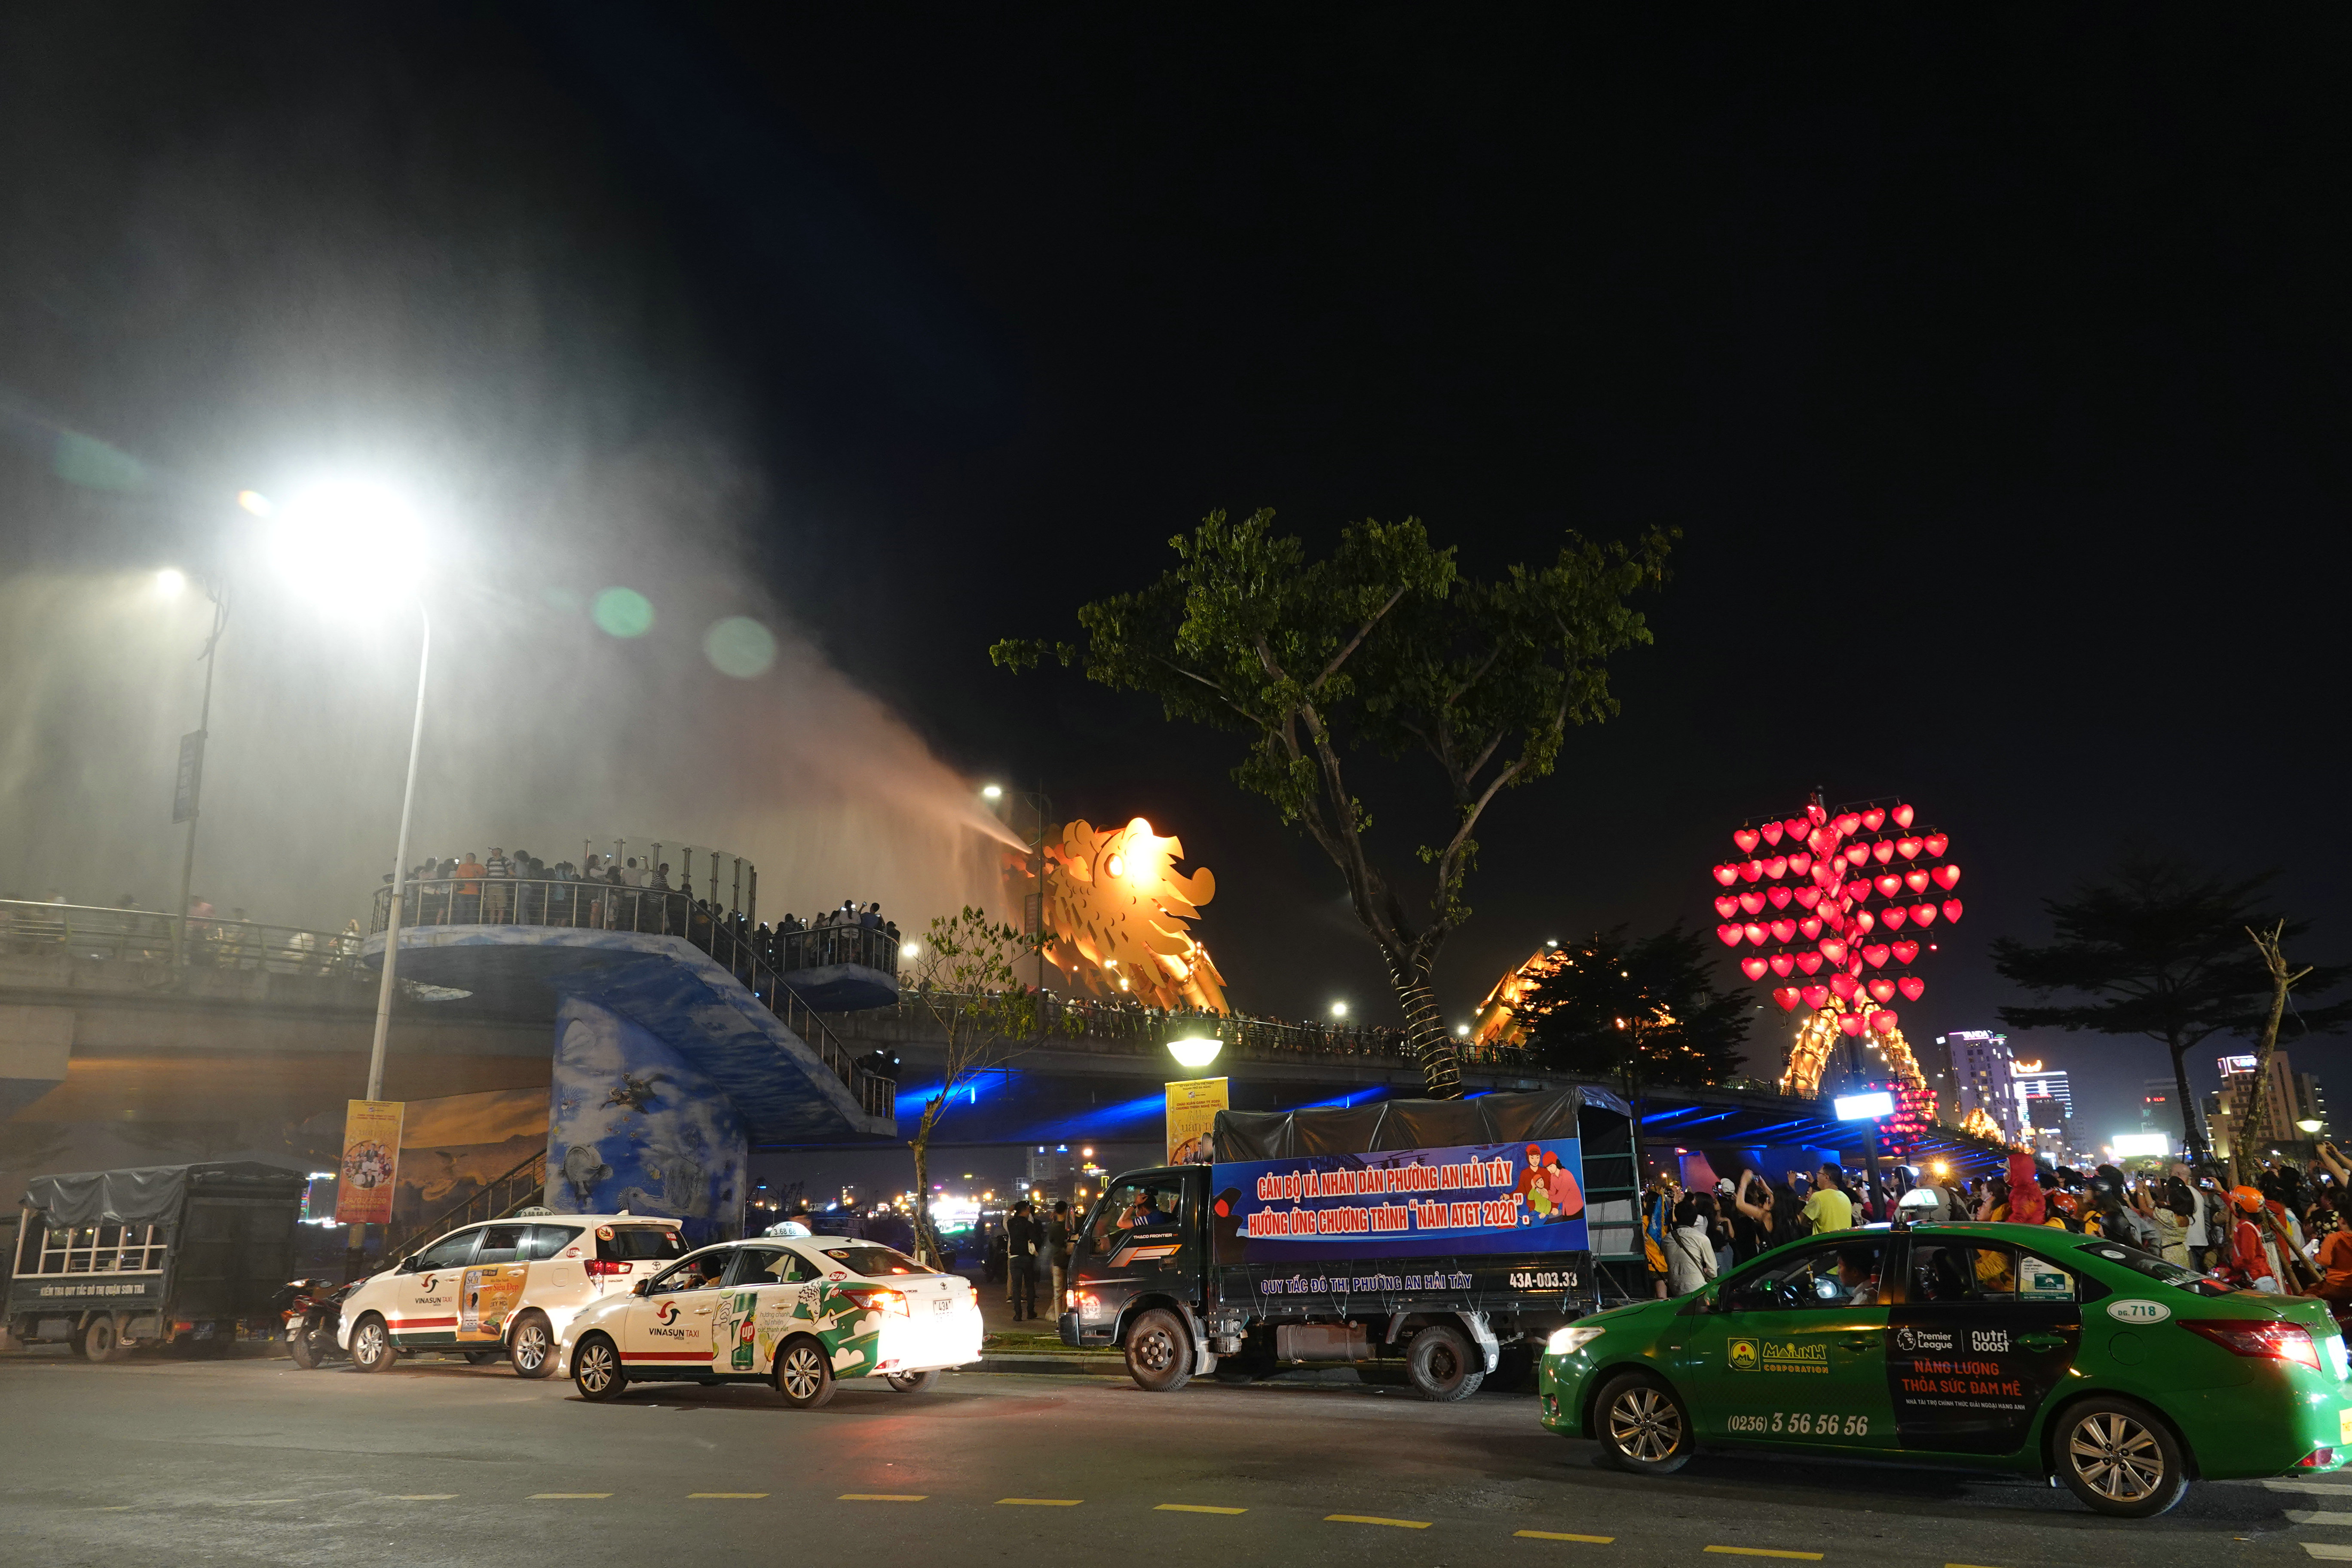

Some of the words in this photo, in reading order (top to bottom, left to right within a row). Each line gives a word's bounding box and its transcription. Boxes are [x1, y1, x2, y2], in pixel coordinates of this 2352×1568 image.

[1962, 1030, 1989, 1038] VANDA
[1258, 1173, 1283, 1200] CÁN
[1284, 1170, 1302, 1203] BỘ
[1303, 1170, 1320, 1197] VÀ
[1321, 1168, 1356, 1196] NHÂN
[1357, 1166, 1385, 1194] DÂN
[1386, 1162, 1439, 1193] PHƯỜNG
[1441, 1164, 1461, 1189] AN
[1461, 1156, 1485, 1188] HẢI
[1486, 1157, 1512, 1186] TÂY
[1248, 1206, 1289, 1237] HƯỞNG
[1290, 1207, 1317, 1234] ỨNG
[1317, 1207, 1369, 1234] CHƯƠNG
[1369, 1202, 1409, 1231] TRÌNH
[1450, 1201, 1481, 1228] ATGT
[1261, 1279, 1283, 1295] QUY
[1286, 1274, 1308, 1293] TẮC
[1310, 1275, 1327, 1292] ĐÔ
[1329, 1278, 1350, 1295] THỊ
[1353, 1274, 1401, 1292] PHƯỜNG
[1405, 1275, 1421, 1290] AN
[1424, 1271, 1446, 1289] HẢI
[1449, 1271, 1472, 1289] TÂY
[1510, 1271, 1578, 1288] 43A-003.33
[939, 1301, 949, 1311] 43A
[2130, 1305, 2156, 1316] 718
[649, 1328, 684, 1337] VINASUN
[1917, 1331, 1952, 1341] Premier
[1972, 1329, 2008, 1342] nutri
[1918, 1339, 1953, 1351] League
[1972, 1339, 2009, 1352] boost
[1764, 1364, 1828, 1374] CORPORATION
[1914, 1358, 1951, 1374] NĂNG
[1955, 1361, 1999, 1379] LƯỢNG
[1902, 1376, 1938, 1393] THỎA
[1940, 1378, 1966, 1393] SỨC
[1969, 1381, 1999, 1395] ĐAM
[2002, 1380, 2022, 1396] MÊ
[1728, 1415, 1767, 1434] (0236)
[1772, 1412, 1783, 1432] 3
[1788, 1413, 1811, 1434] 56
[1816, 1414, 1839, 1435] 56
[1844, 1415, 1868, 1436] 56
